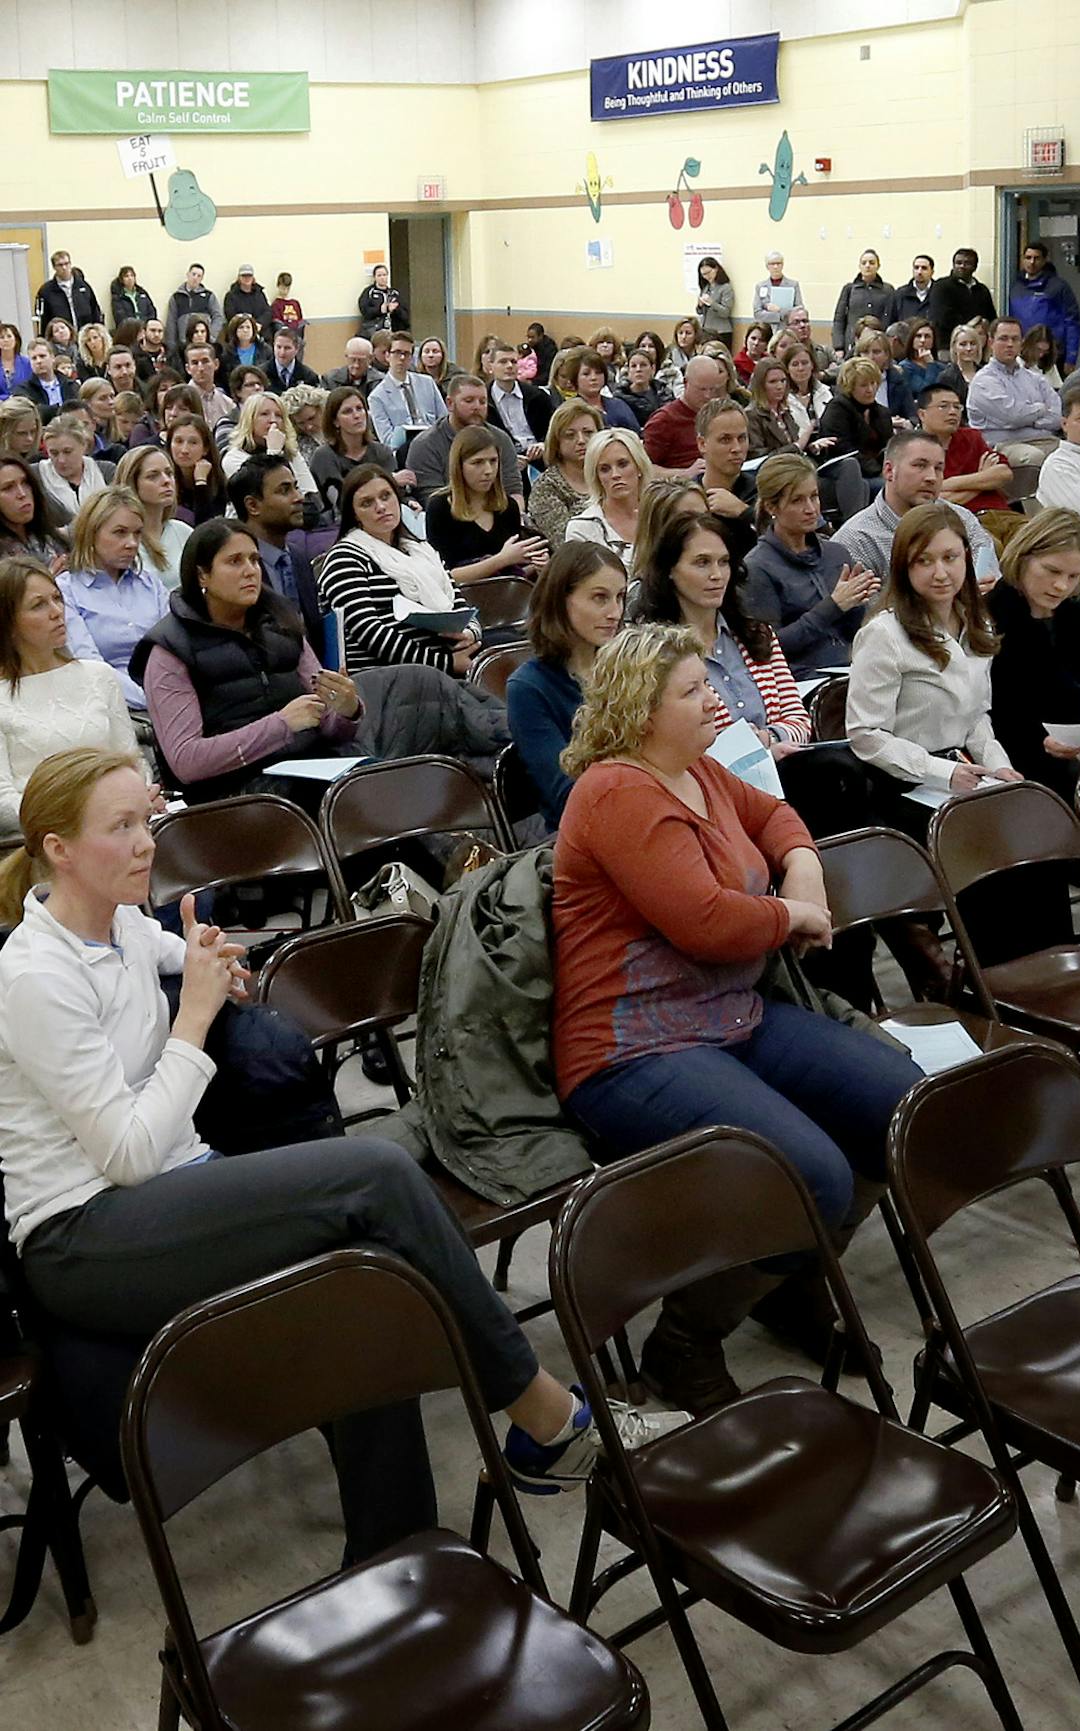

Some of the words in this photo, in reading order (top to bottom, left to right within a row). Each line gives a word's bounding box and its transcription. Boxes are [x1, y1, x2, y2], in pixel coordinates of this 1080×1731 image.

[628, 49, 735, 90] KINDNESS
[116, 81, 249, 108] PATIENCE
[604, 96, 626, 110] Being
[627, 90, 668, 107] Thoughtful
[669, 87, 685, 101] and
[685, 84, 721, 100] Thinking
[722, 82, 733, 96] of
[732, 81, 763, 95] Others
[137, 111, 166, 124] Calm
[168, 111, 189, 124] Self
[192, 111, 231, 124] Control
[130, 134, 152, 149] EAT
[131, 155, 167, 173] FRUIT
